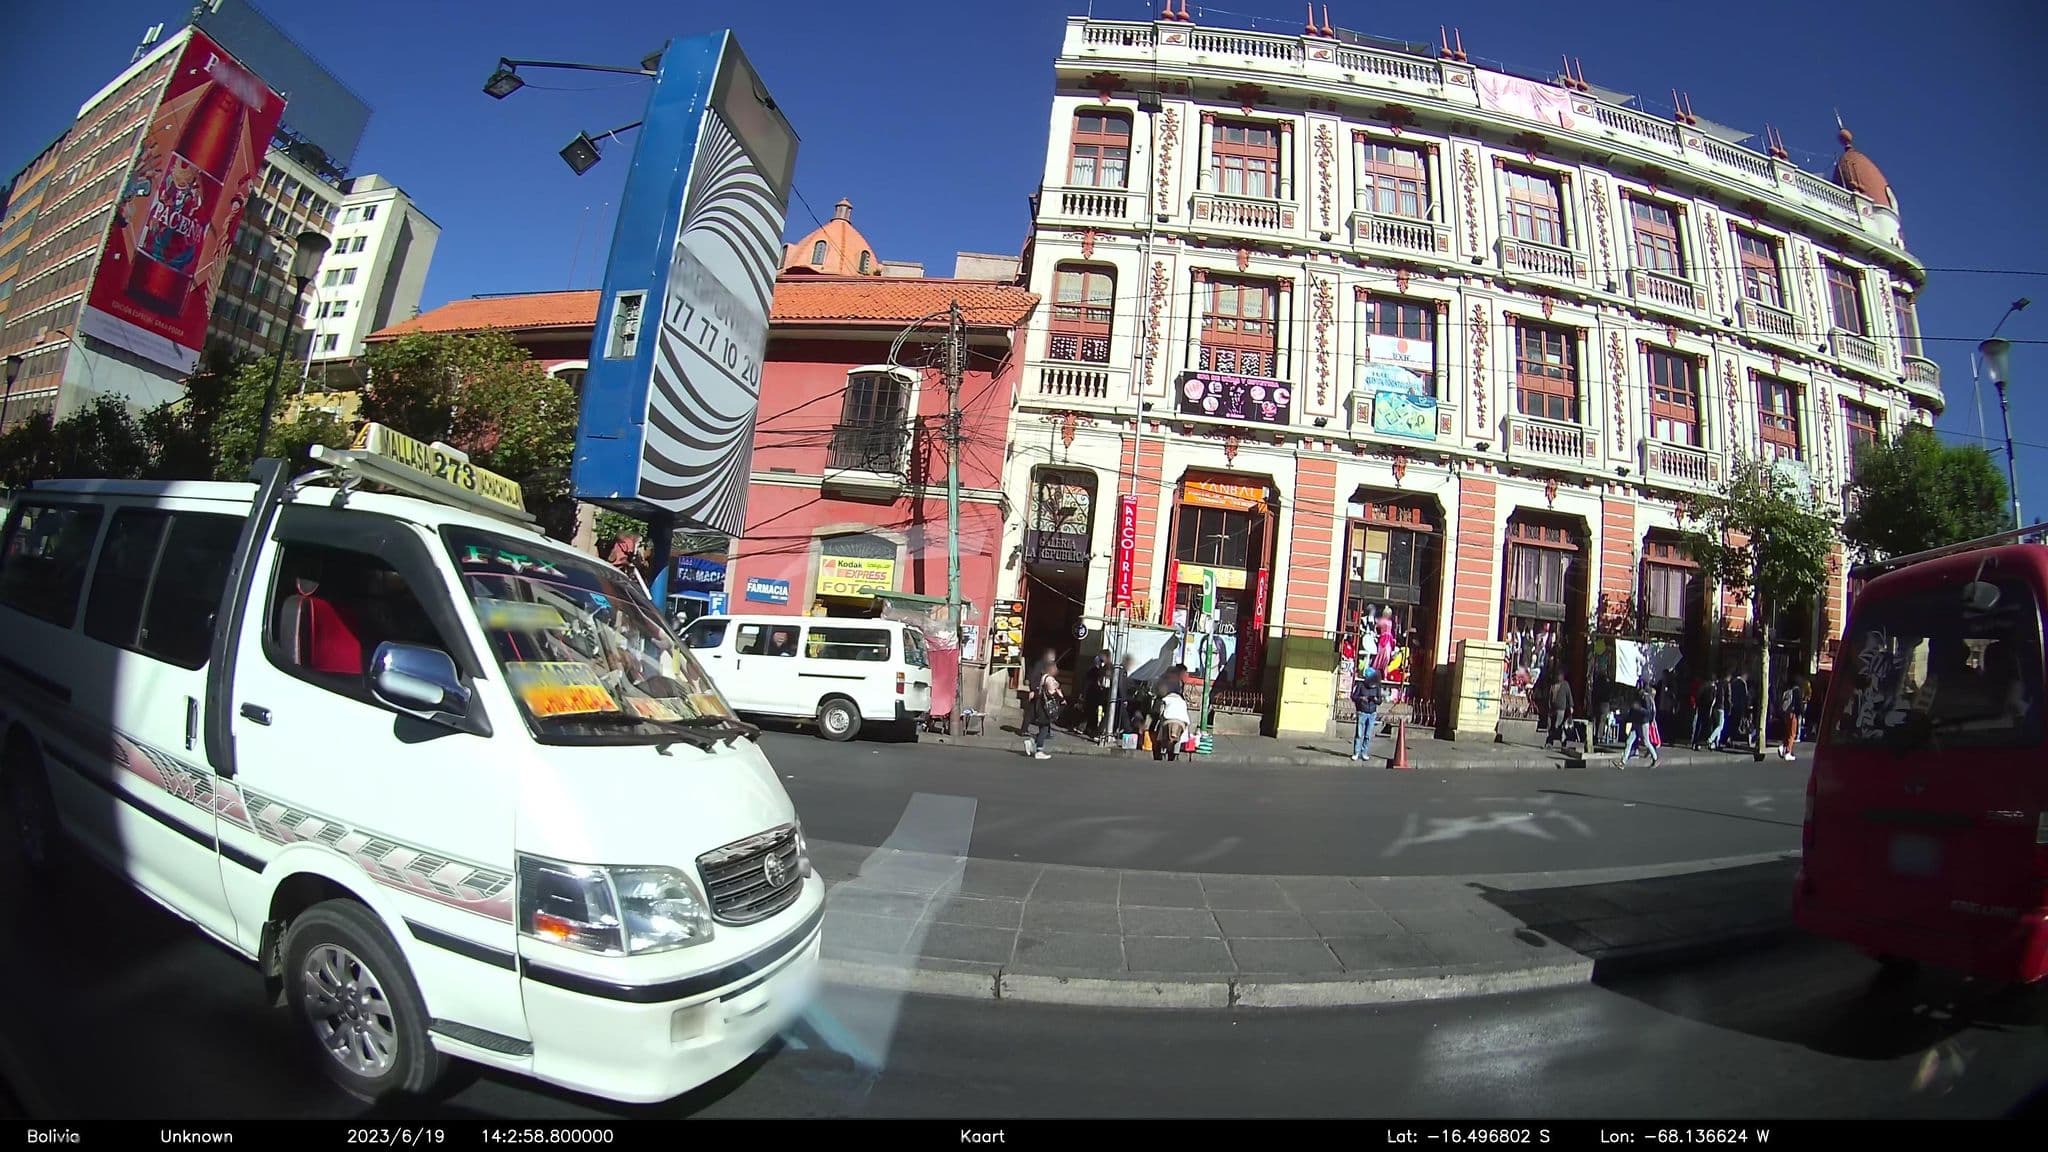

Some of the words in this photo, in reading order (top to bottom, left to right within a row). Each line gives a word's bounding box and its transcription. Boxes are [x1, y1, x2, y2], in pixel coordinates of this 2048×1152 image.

[673, 294, 695, 332] 77
[699, 316, 719, 352] 77
[722, 337, 738, 369] 10
[741, 355, 759, 387] 20
[434, 452, 477, 491] 273
[1200, 481, 1255, 498] YANBAL
[1121, 505, 1135, 595] ARCOIRIS
[838, 560, 863, 569] Kodak
[846, 569, 888, 581] EXPRESS
[746, 582, 789, 596] FARMACIA
